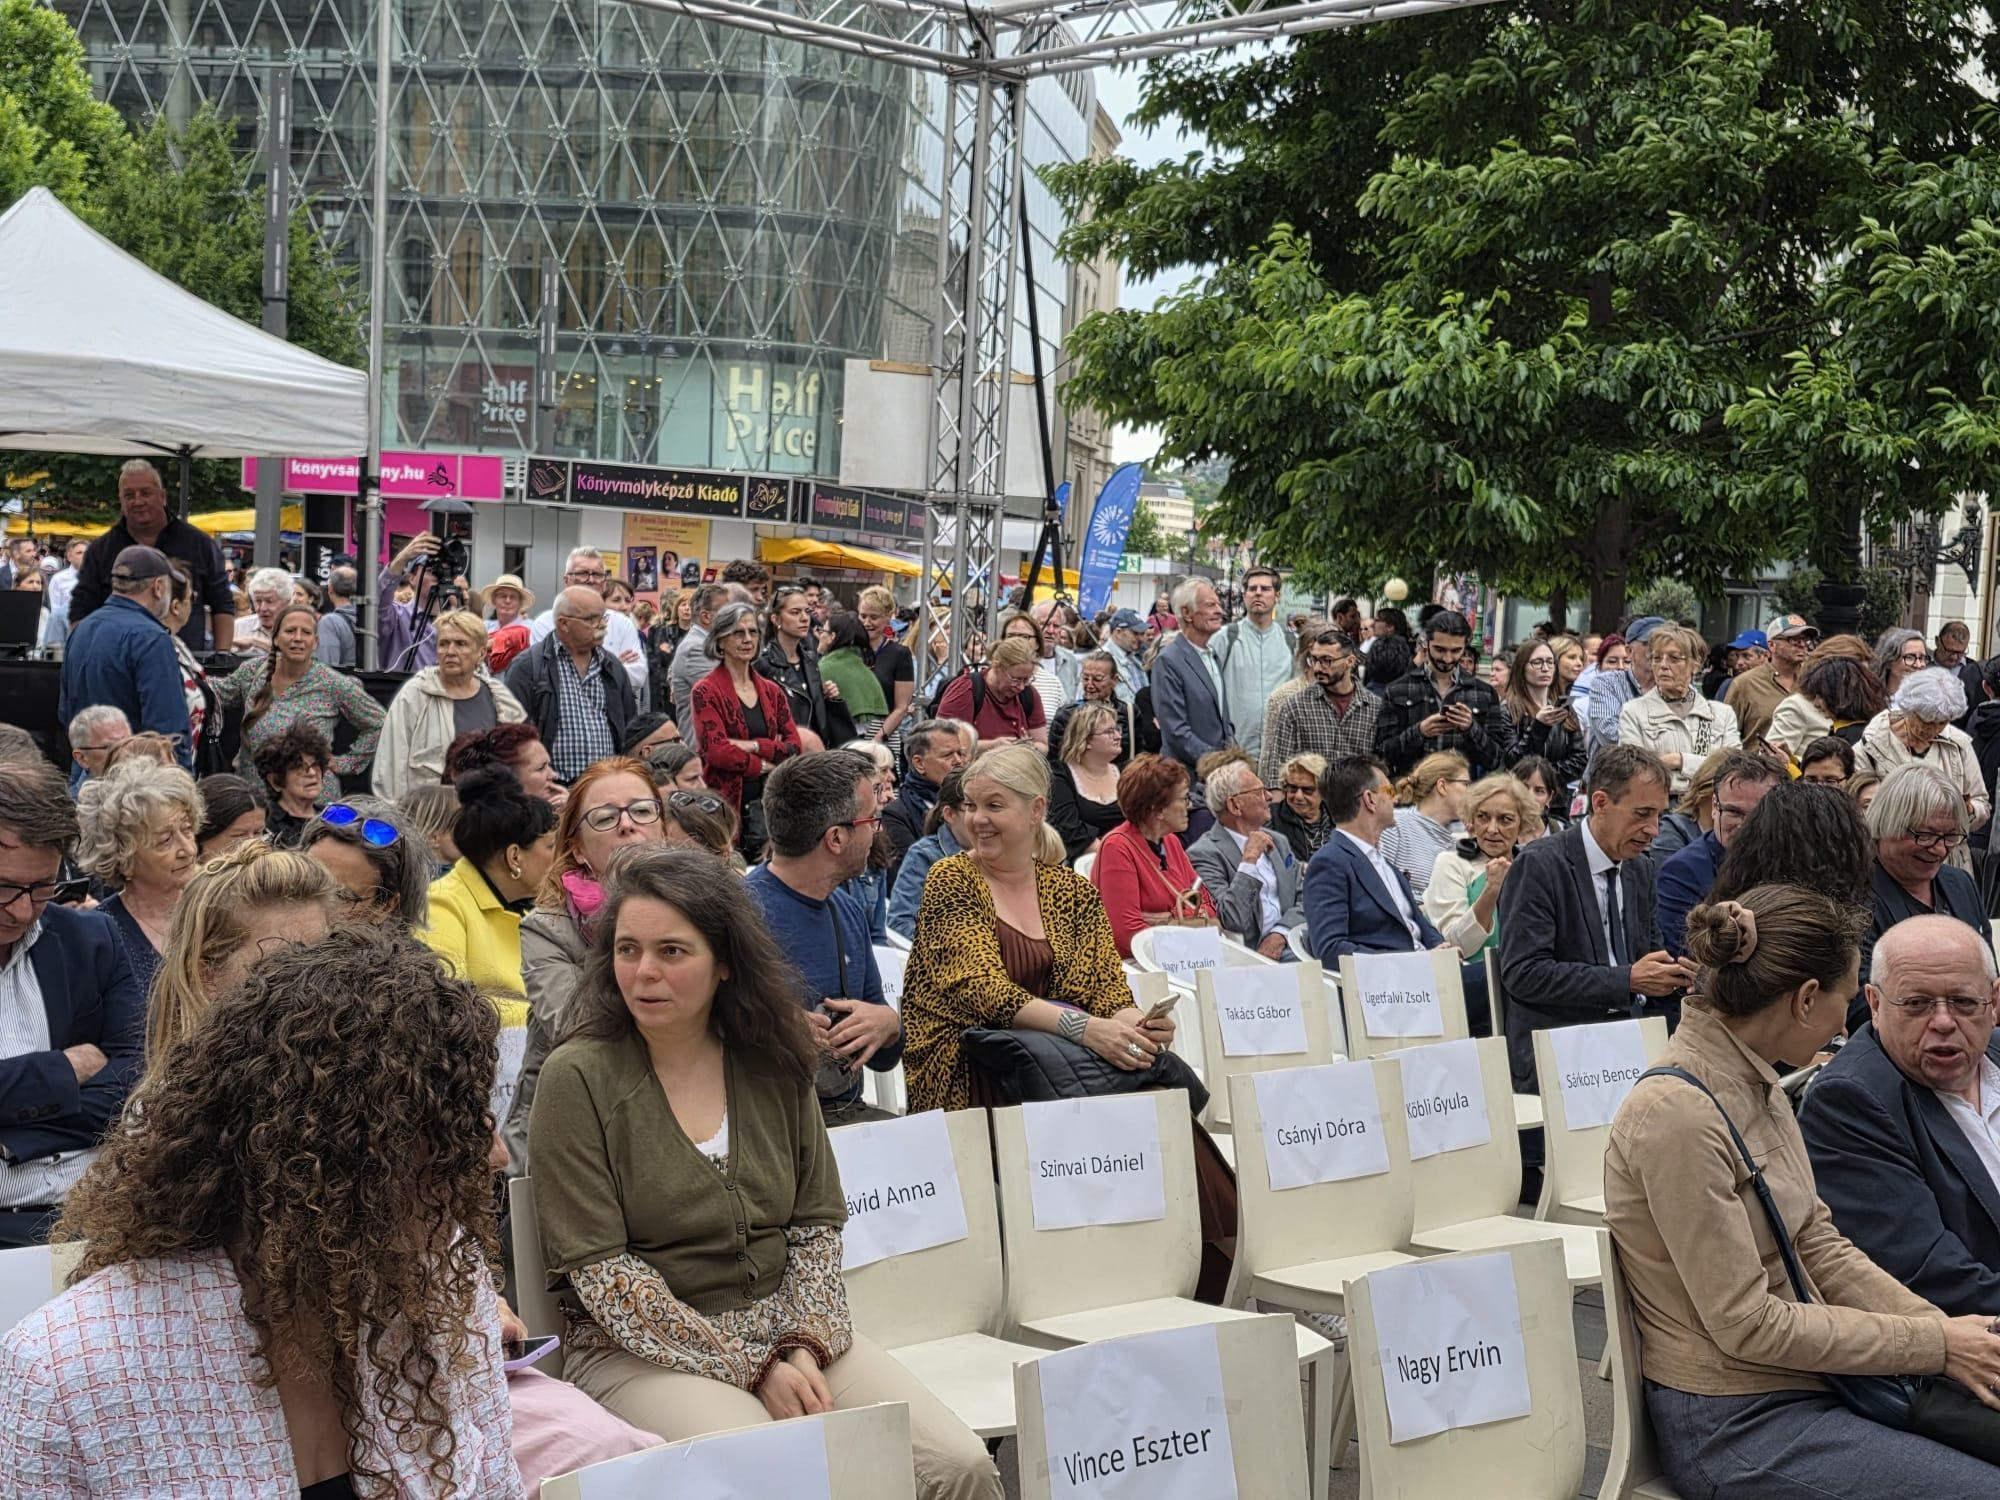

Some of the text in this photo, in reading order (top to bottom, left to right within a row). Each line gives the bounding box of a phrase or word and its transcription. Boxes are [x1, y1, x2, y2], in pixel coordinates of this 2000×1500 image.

[728, 366, 820, 417] Half
[726, 412, 817, 459] Price
[698, 484, 739, 503] Kiadó
[1187, 957, 1215, 969] Katalin
[1405, 990, 1431, 1004] Zsolt
[1225, 1005, 1291, 1020] Takács Gábor
[1566, 1067, 1640, 1088] Sárközy Bence
[1405, 1091, 1469, 1119] Köbli Gyula
[1277, 1118, 1366, 1146] Csányi Dóra
[1040, 1152, 1144, 1178] Szinvai Dániel
[846, 1181, 936, 1216] ávid Anna
[1397, 1340, 1502, 1385] Nagy Ervin
[1063, 1428, 1211, 1486] Vince Eszter
